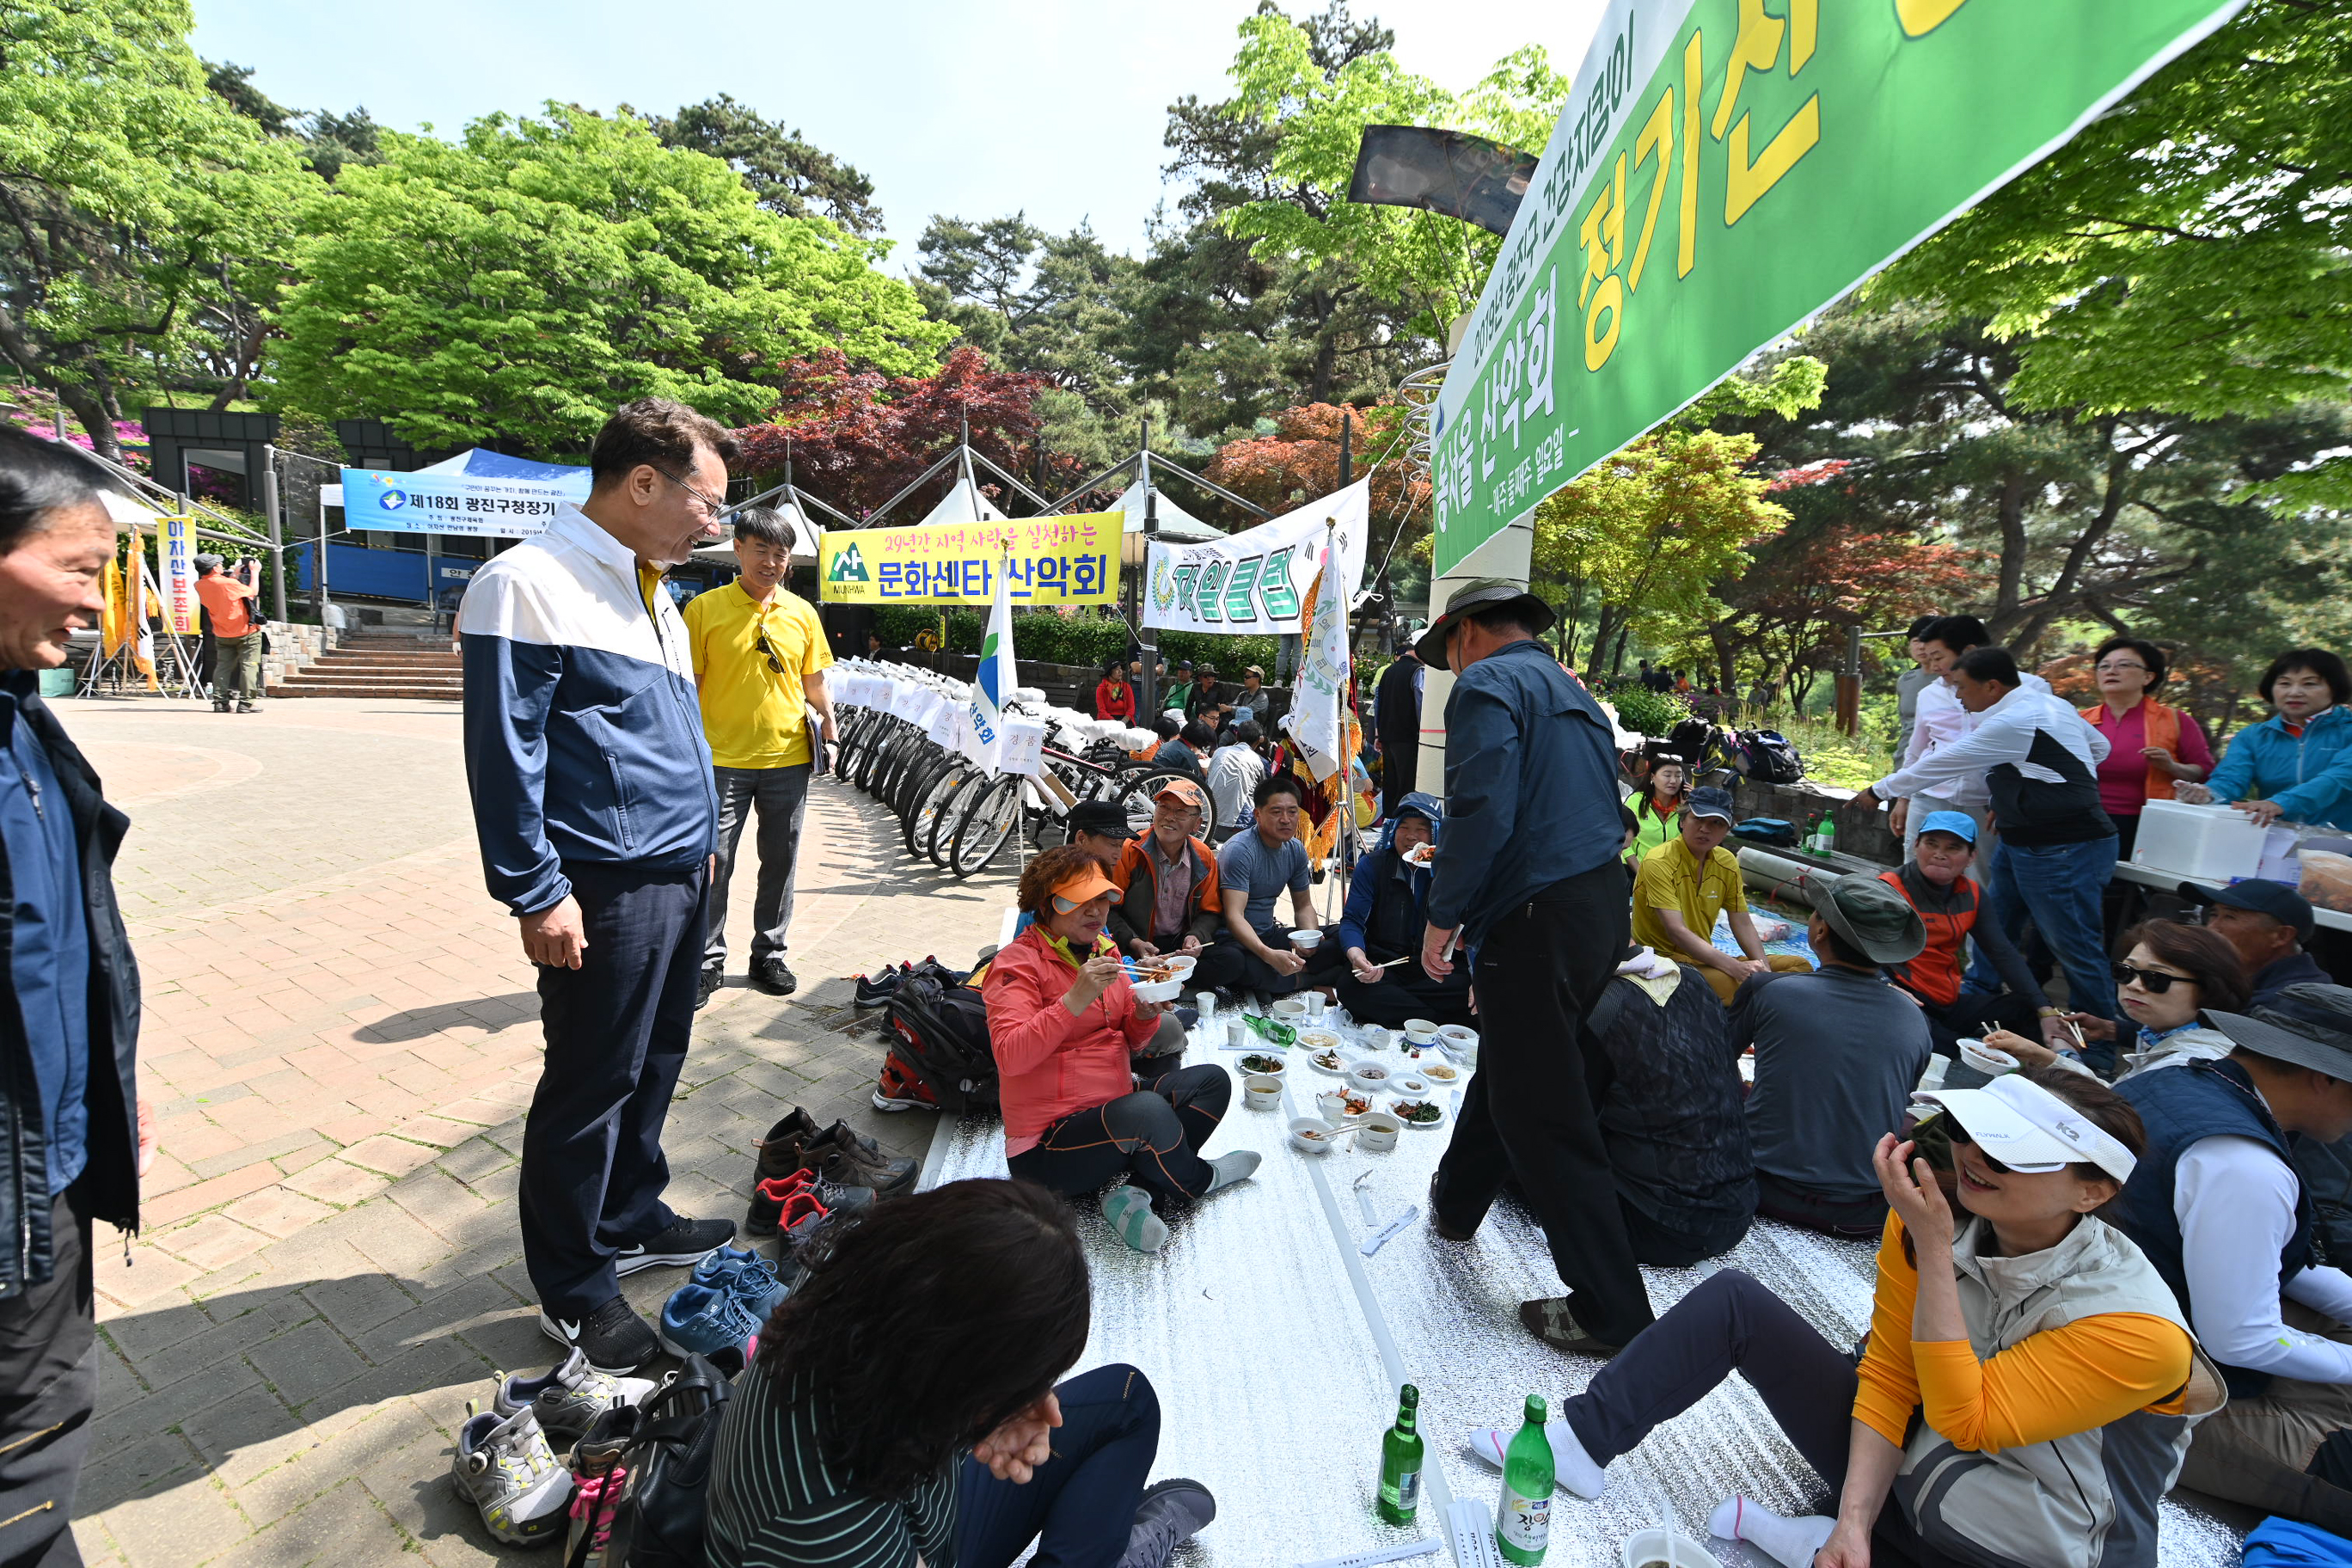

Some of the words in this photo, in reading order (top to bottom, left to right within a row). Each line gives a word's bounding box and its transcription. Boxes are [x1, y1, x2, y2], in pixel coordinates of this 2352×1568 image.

[1474, 275, 1504, 369] 2019년
[1505, 210, 1538, 309] 광진구
[1543, 9, 1633, 244] 건강지킴이
[1436, 407, 1473, 534] 동서울
[1480, 262, 1558, 483] 산악회
[1508, 456, 1532, 507] 둘째주
[1535, 422, 1563, 486] 일요일
[410, 493, 458, 511] 제18회
[465, 497, 555, 516] 광진구청장기
[885, 533, 931, 554] 29년간
[936, 530, 965, 553] 지역
[971, 526, 1016, 552] 사랑을
[1026, 522, 1098, 549] 실천하는
[834, 549, 862, 581] 산
[878, 559, 992, 597] 문화센타
[1009, 554, 1107, 597] 산악회
[1173, 544, 1300, 623] 자일클럽
[833, 585, 865, 595] MUNHWA
[969, 701, 995, 744] 산악회
[2055, 1121, 2080, 1142] K2
